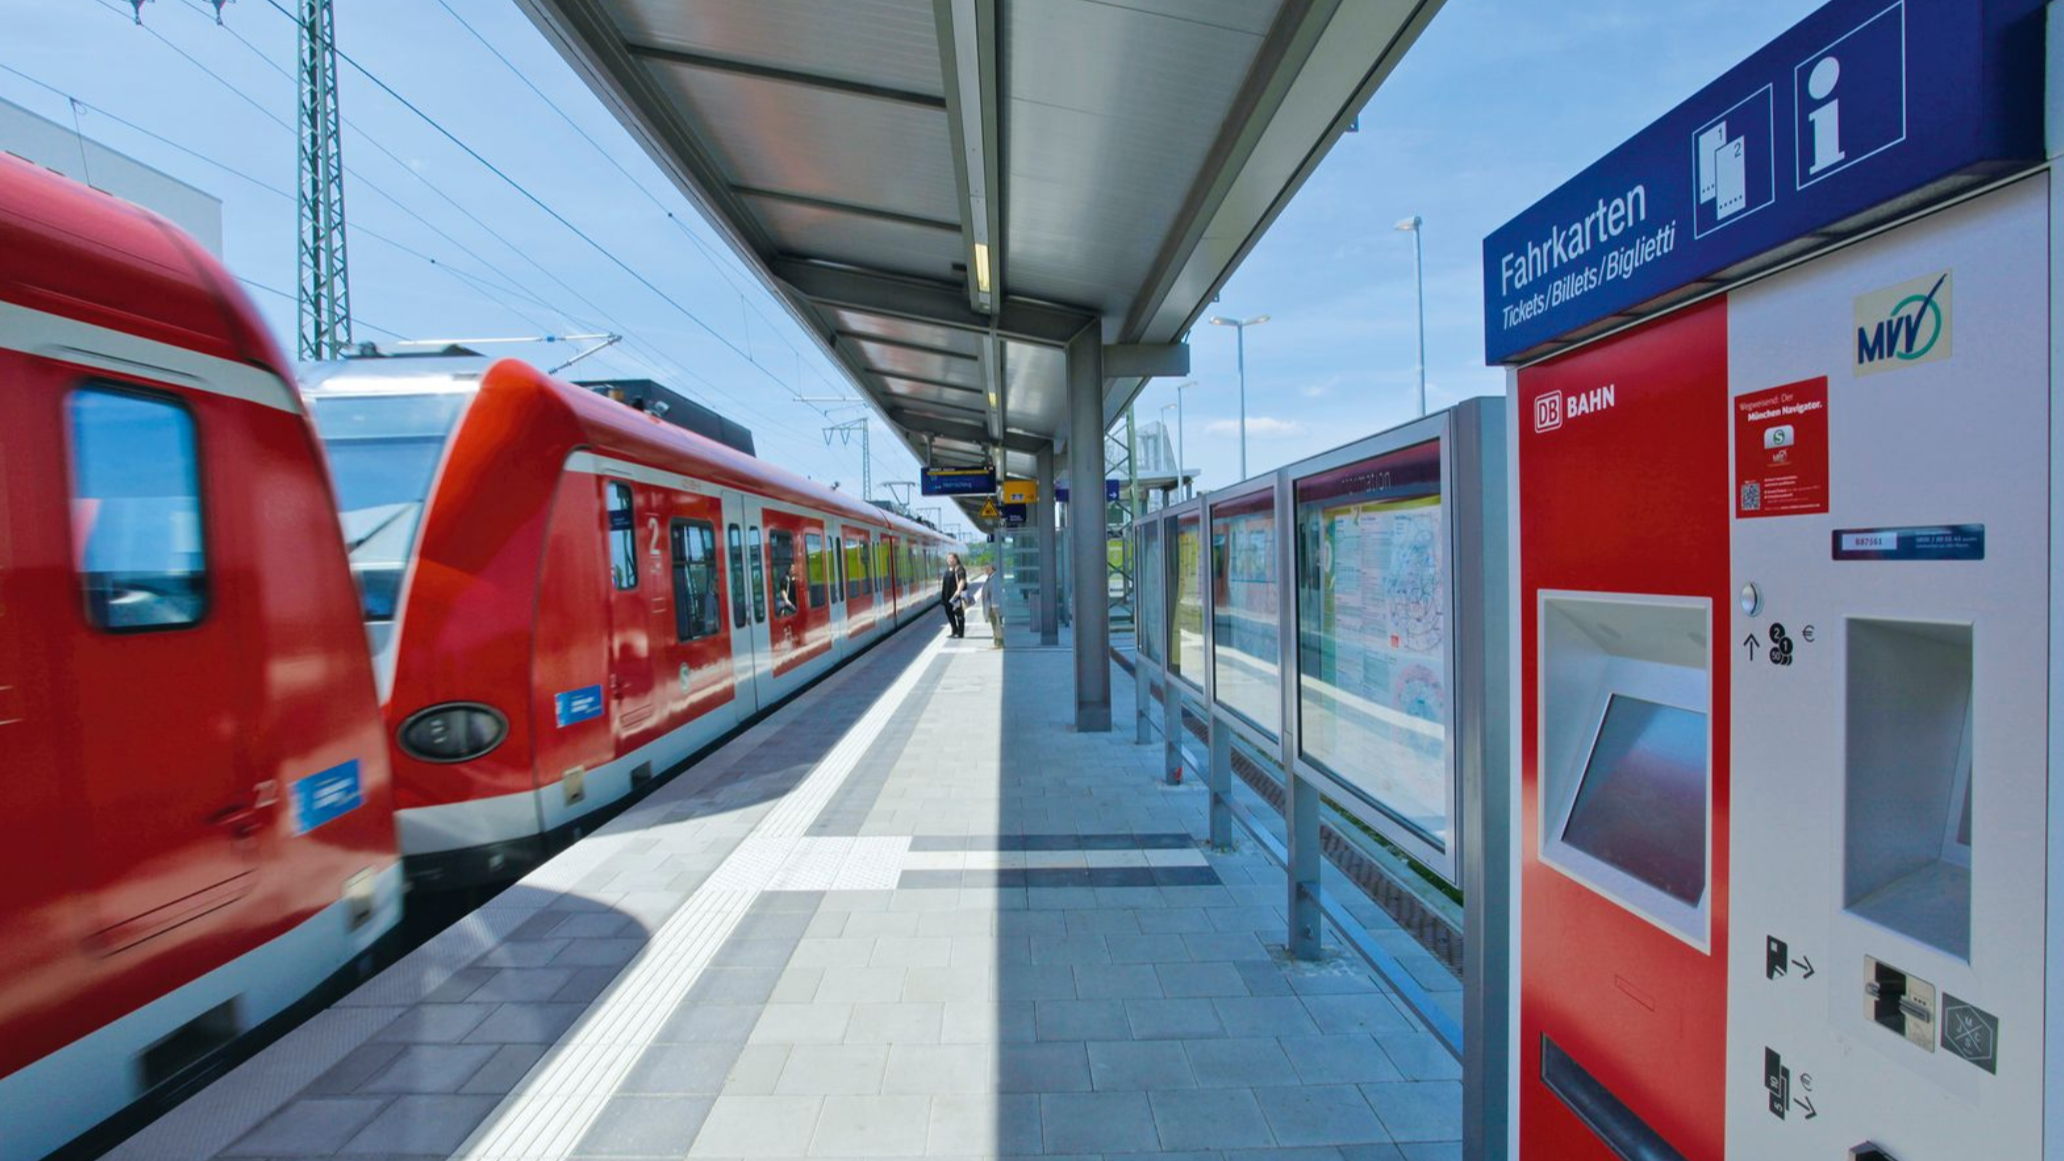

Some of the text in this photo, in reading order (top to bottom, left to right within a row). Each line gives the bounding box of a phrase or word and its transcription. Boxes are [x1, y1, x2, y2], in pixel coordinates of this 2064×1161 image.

[1734, 142, 1741, 158] 2
[1501, 184, 1646, 296] Fahrkarten
[1502, 219, 1677, 330] Tickets/Billets/Biglietti
[1858, 273, 1947, 365] MVV
[1539, 384, 1615, 425] DB BAHN
[1747, 401, 1823, 422] München Navigator.
[648, 517, 660, 555] 2
[1773, 627, 1781, 640] 2
[1783, 640, 1789, 652] 1
